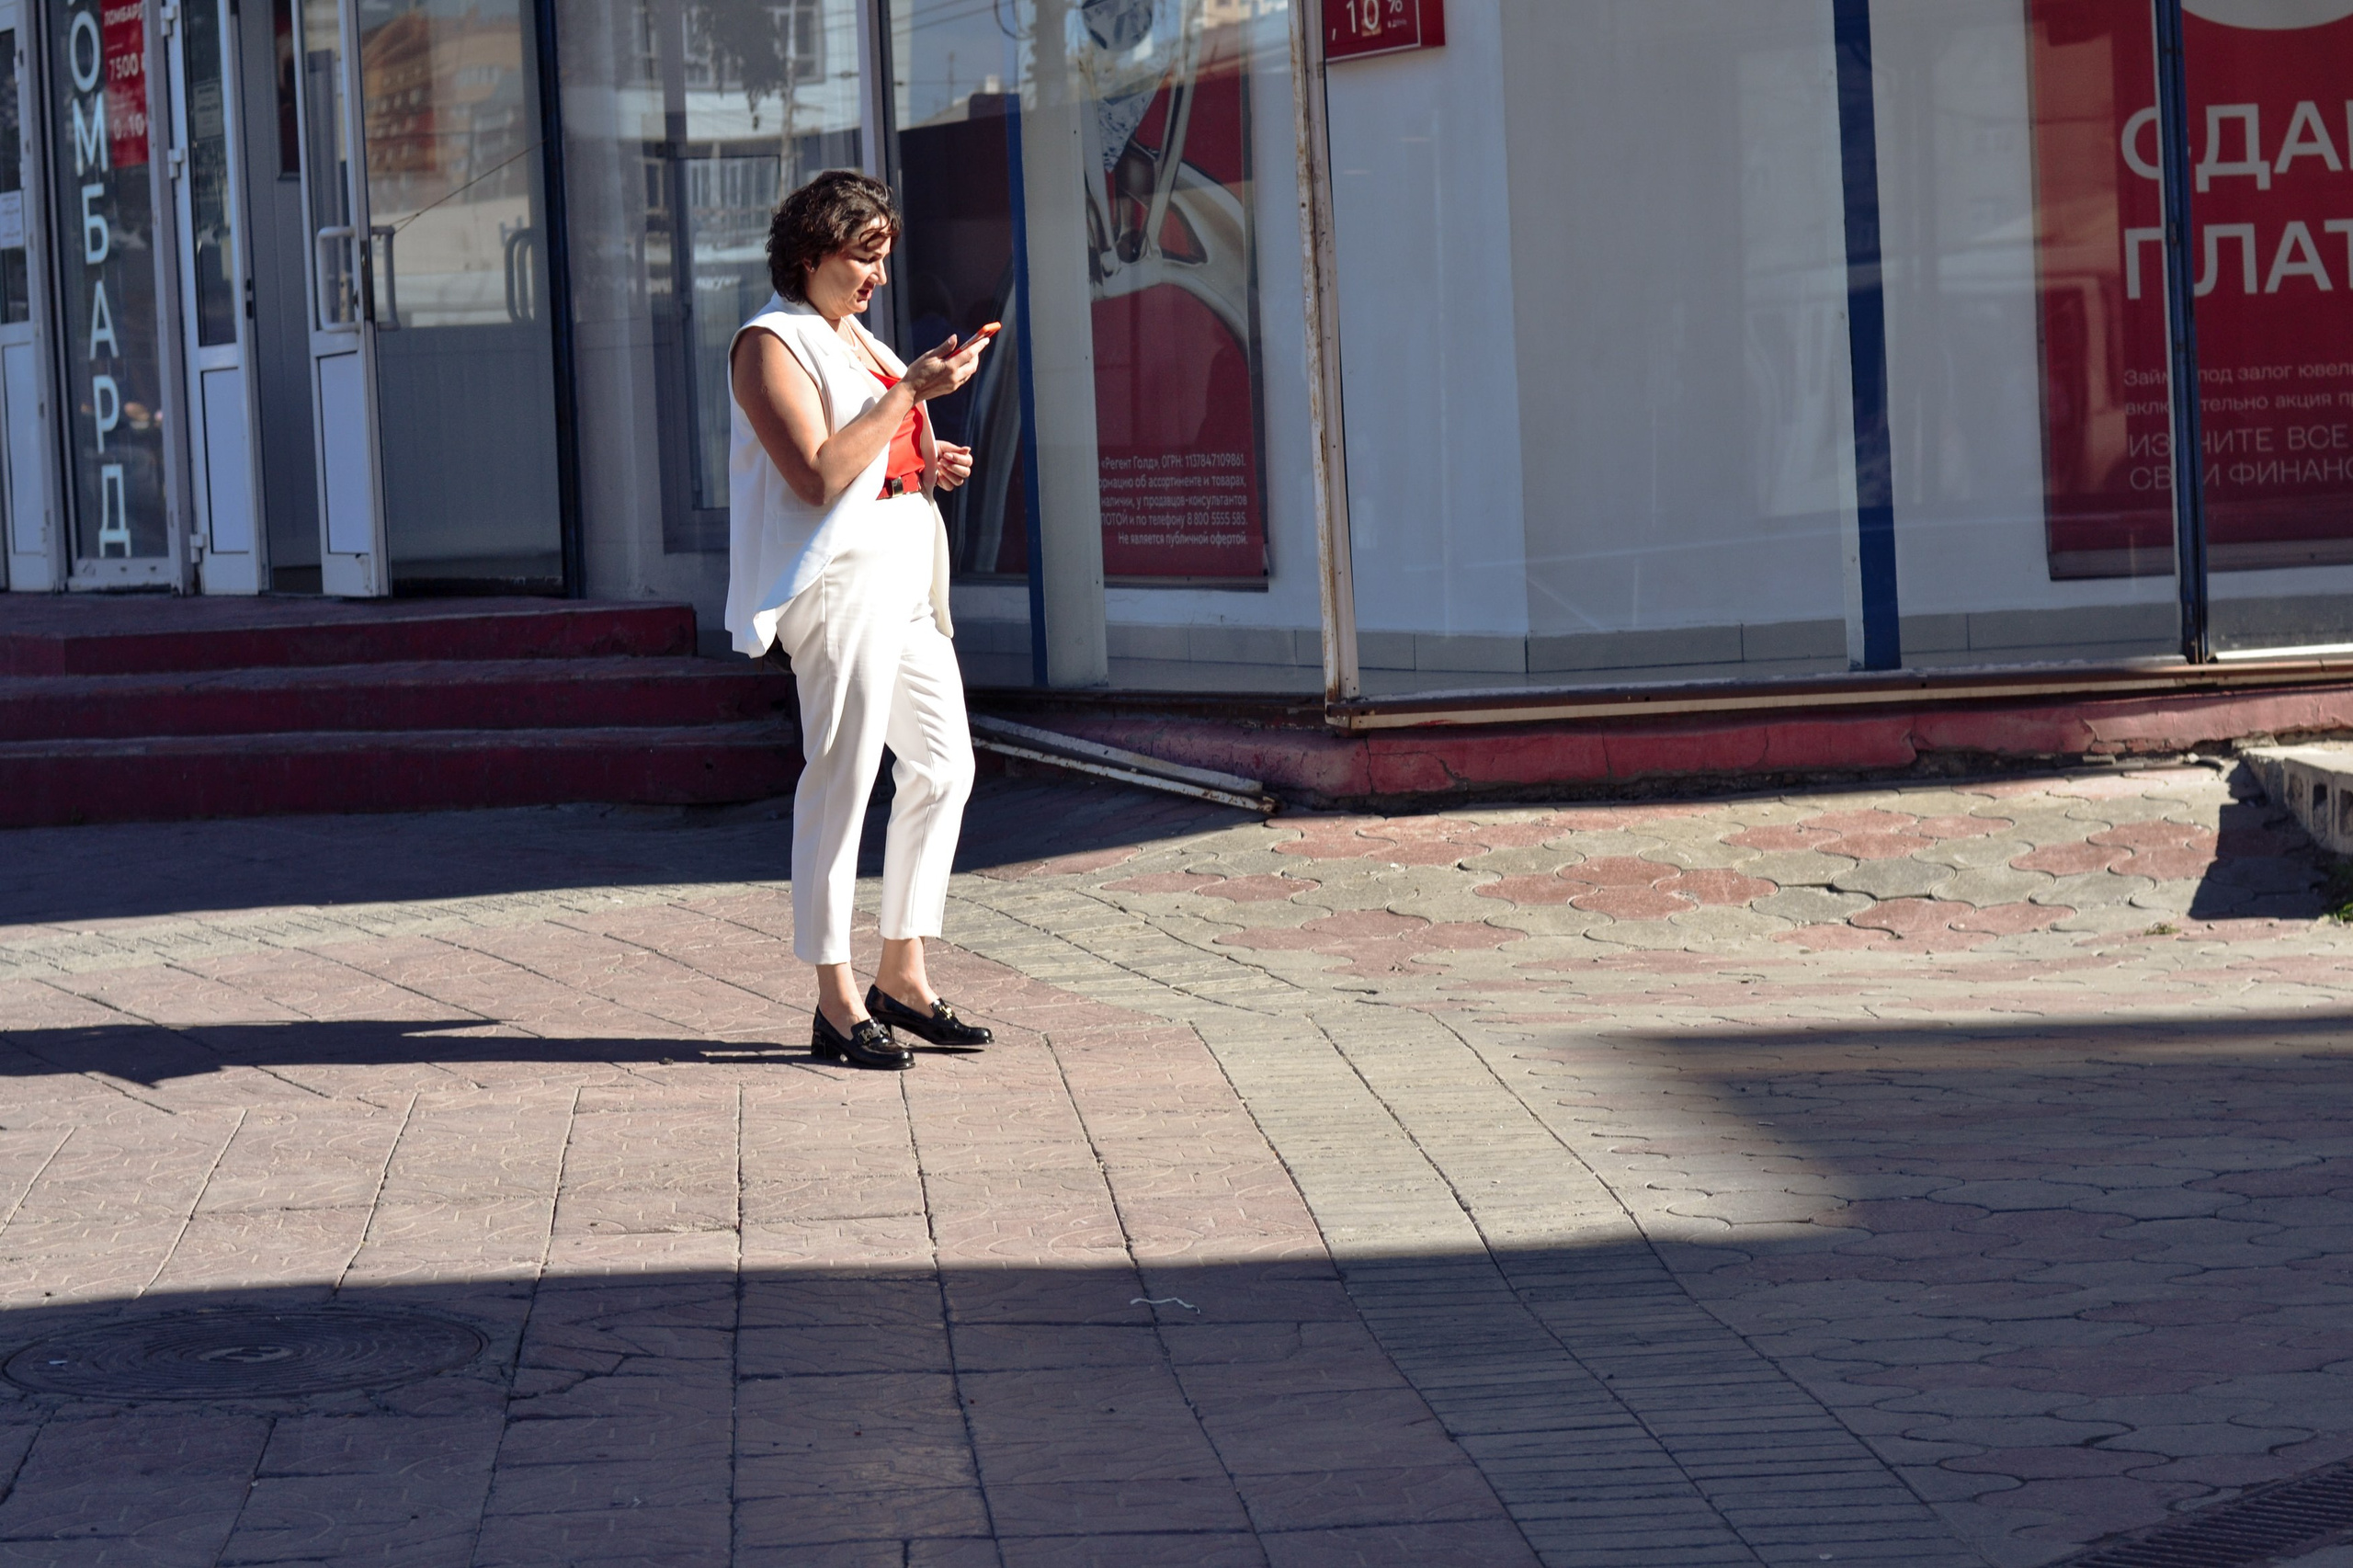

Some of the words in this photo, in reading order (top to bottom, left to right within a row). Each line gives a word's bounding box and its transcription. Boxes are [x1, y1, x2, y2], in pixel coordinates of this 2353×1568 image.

[108, 51, 139, 81] 7500
[2121, 99, 2353, 193] СДА
[69, 0, 131, 558] ОМБАРД
[2198, 367, 2234, 384] под
[2238, 364, 2292, 381] залог
[2298, 361, 2353, 378] ювел
[2275, 392, 2332, 410] акция
[2129, 427, 2274, 458] ИЗЧИТЕ
[2288, 424, 2348, 450] ВСЕ
[1162, 454, 1183, 469] ОГРН:
[1135, 473, 1146, 488] об
[1148, 476, 1202, 492] ассортименте
[1203, 477, 1210, 486] и
[1211, 474, 1247, 490] товарах,
[2130, 463, 2220, 491] СВИ
[1136, 496, 1142, 510] у
[1142, 494, 1247, 511] продавцов-консультантов
[1130, 516, 1135, 525] и
[1136, 515, 1147, 526] по
[1149, 512, 1185, 529] телефону
[1187, 512, 1192, 526] 8
[1193, 512, 1210, 526] 800
[1211, 511, 1231, 526] 5555
[1232, 511, 1248, 526] 585.
[1118, 531, 1129, 545] Не
[1131, 532, 1164, 545] является
[1165, 529, 1209, 548] публичной
[1210, 530, 1248, 549] офертой.
